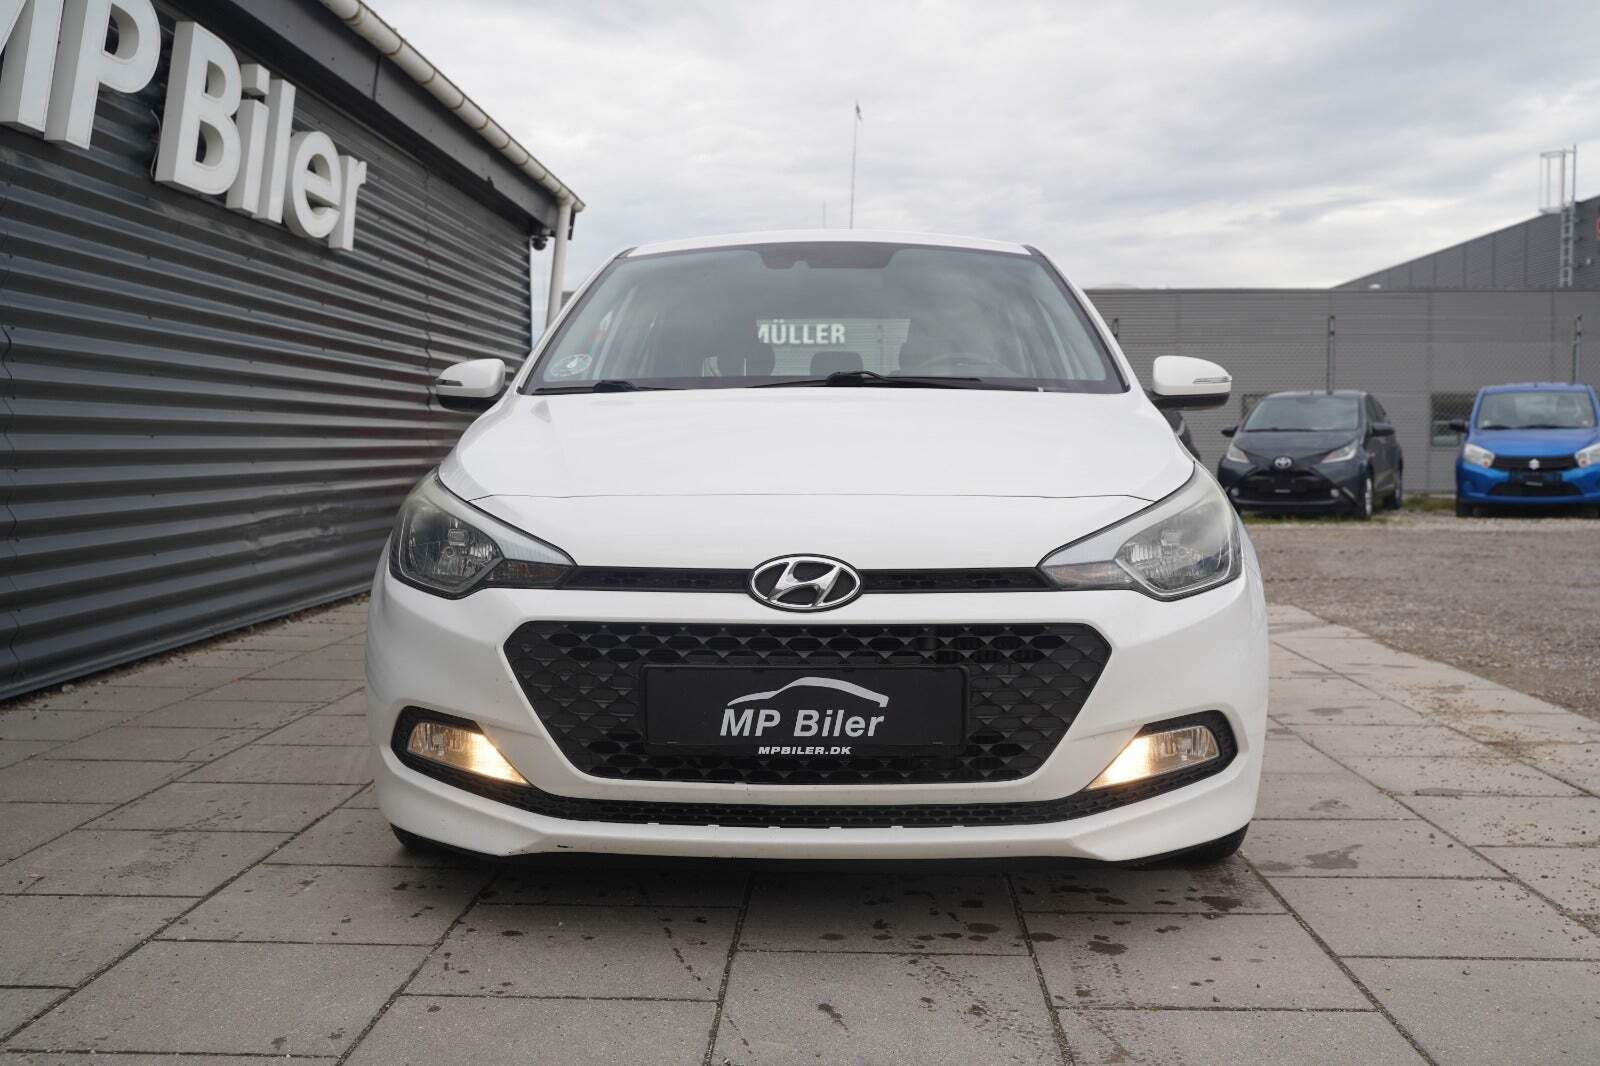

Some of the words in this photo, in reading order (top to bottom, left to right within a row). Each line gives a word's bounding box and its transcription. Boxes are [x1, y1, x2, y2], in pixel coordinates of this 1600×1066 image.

[155, 21, 367, 251] Biler
[719, 708, 781, 737] MP
[793, 709, 885, 738] Biler
[758, 746, 852, 755] MPBILER.DK
